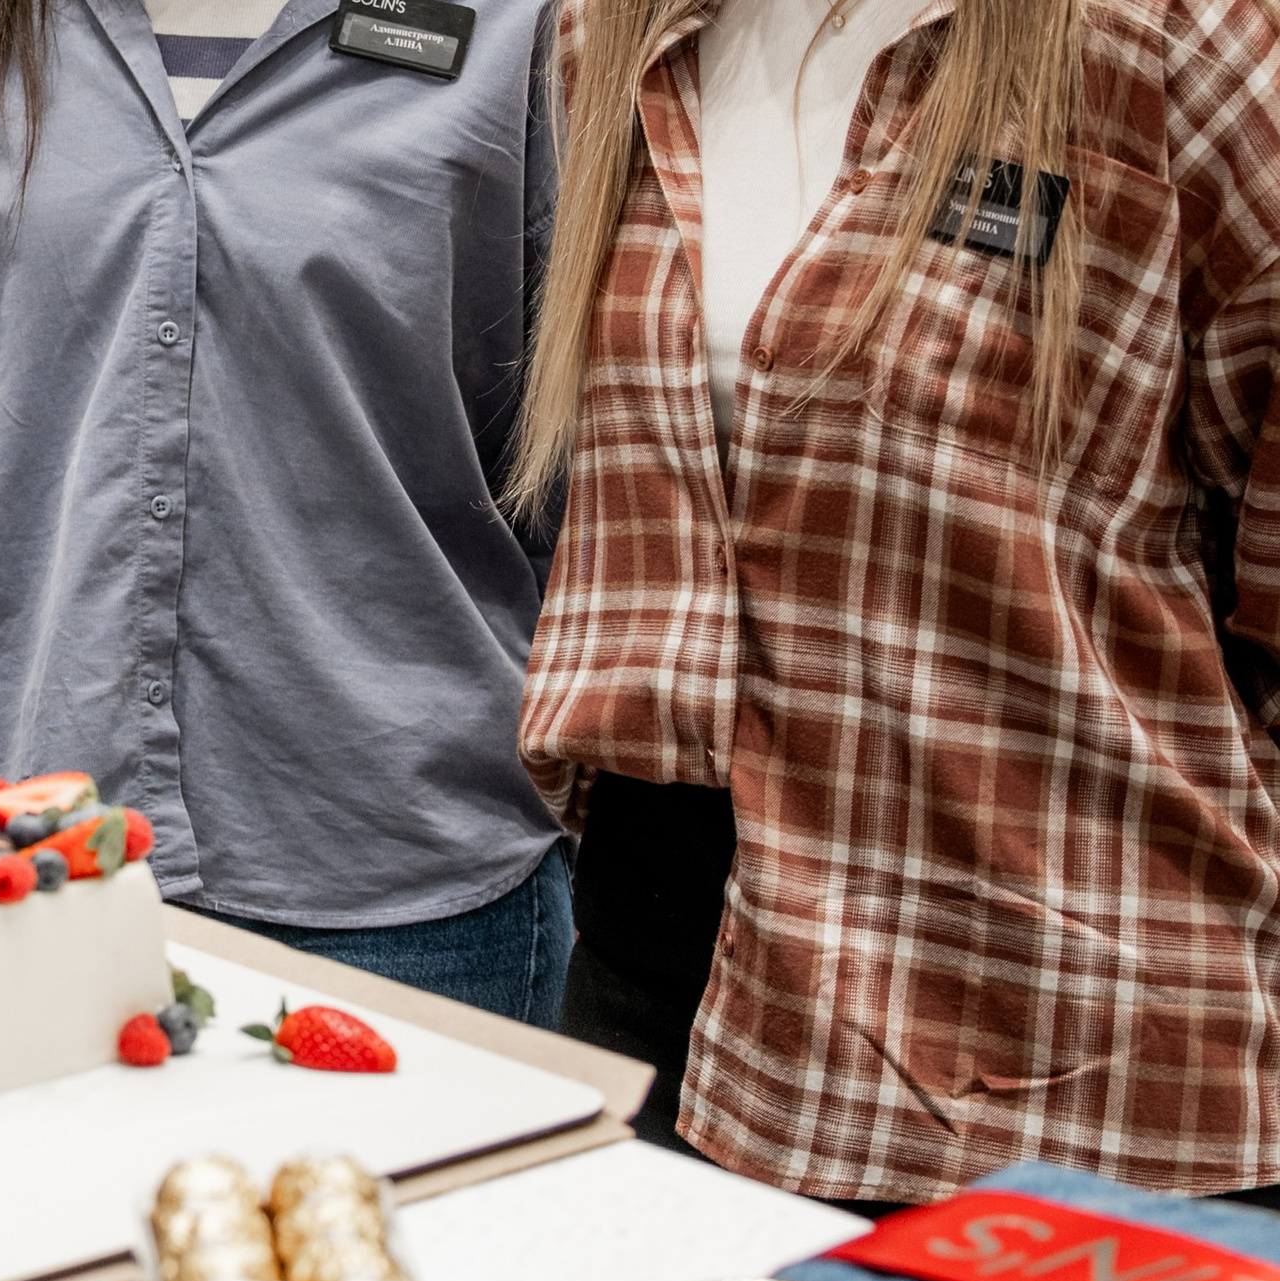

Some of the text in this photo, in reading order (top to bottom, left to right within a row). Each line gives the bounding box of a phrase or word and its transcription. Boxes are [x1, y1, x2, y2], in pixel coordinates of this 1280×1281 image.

[370, 24, 444, 43] Администратор
[384, 37, 423, 52] АЛИНА
[968, 219, 998, 235] ННА
